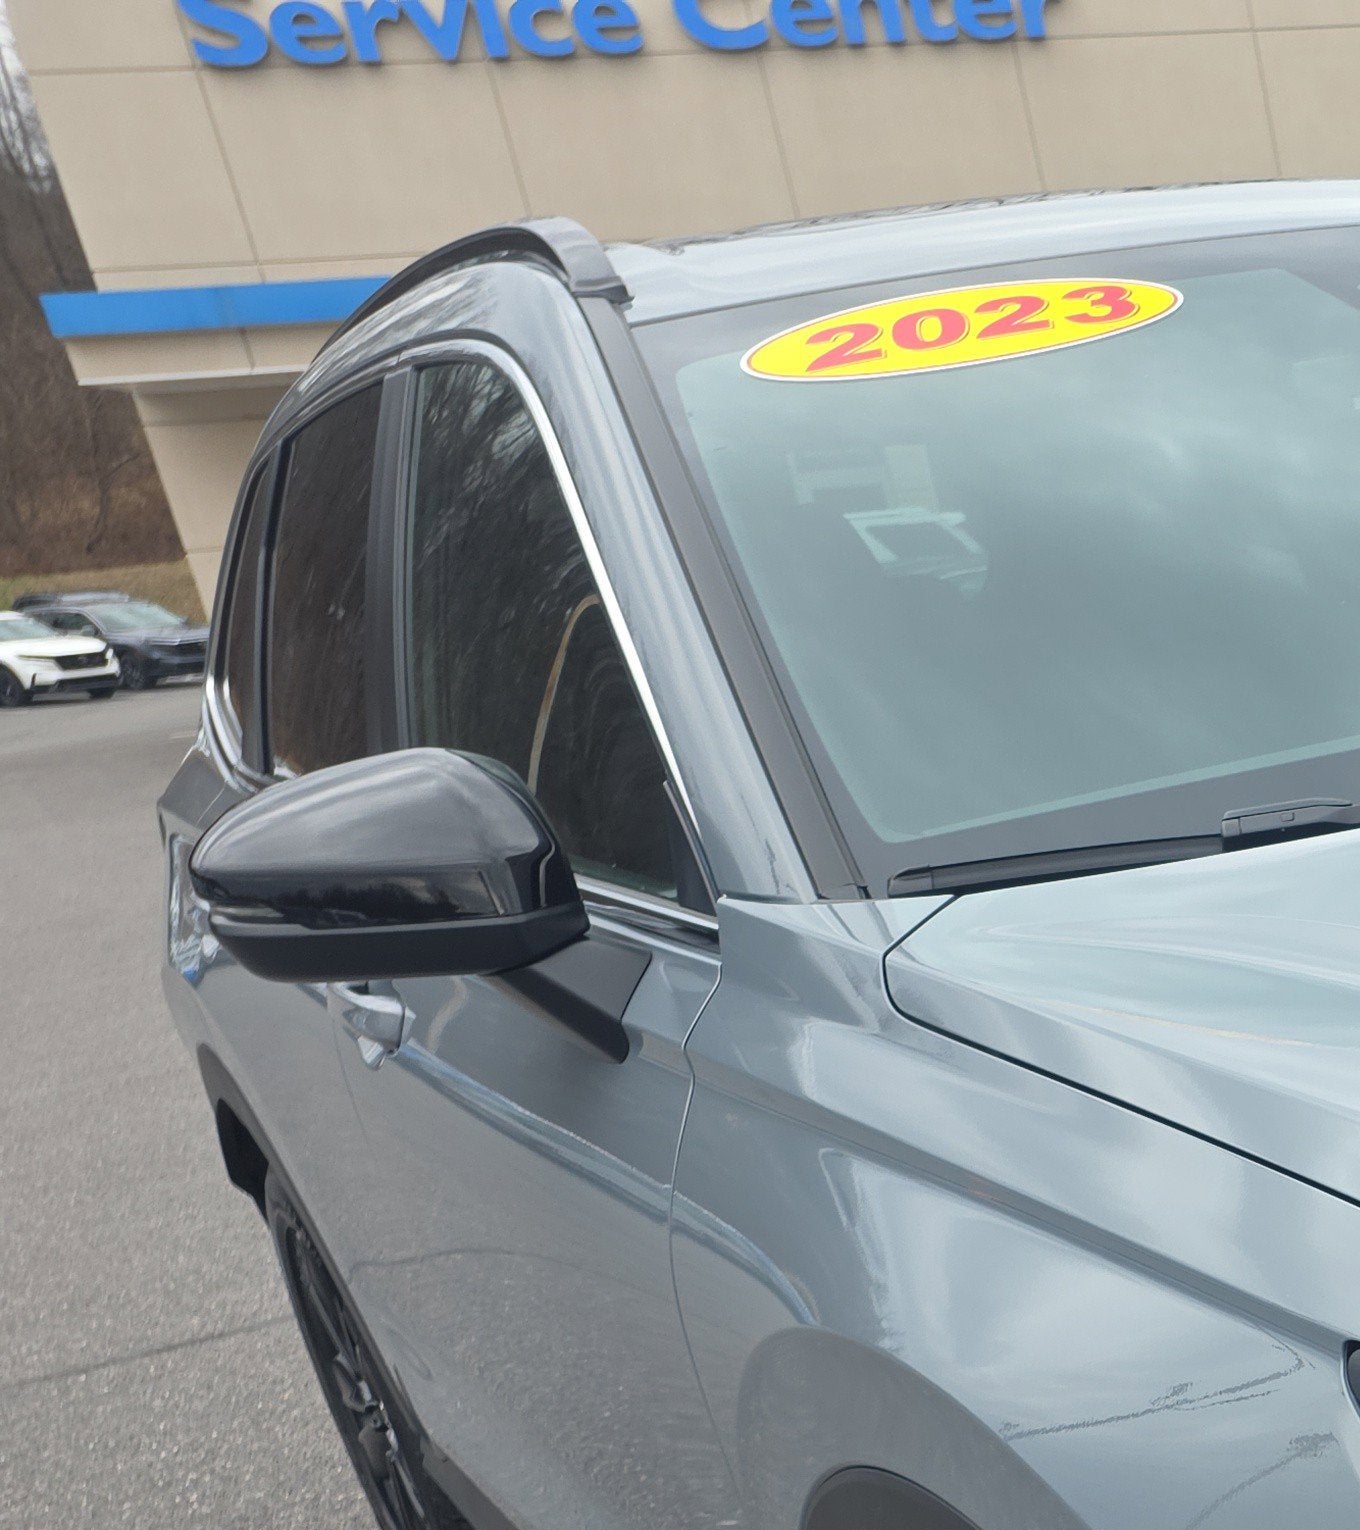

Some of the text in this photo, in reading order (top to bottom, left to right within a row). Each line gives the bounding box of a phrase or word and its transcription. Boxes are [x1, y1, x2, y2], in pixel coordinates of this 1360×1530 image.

[180, 0, 1053, 68] Service Center
[804, 285, 1141, 373] 2023
